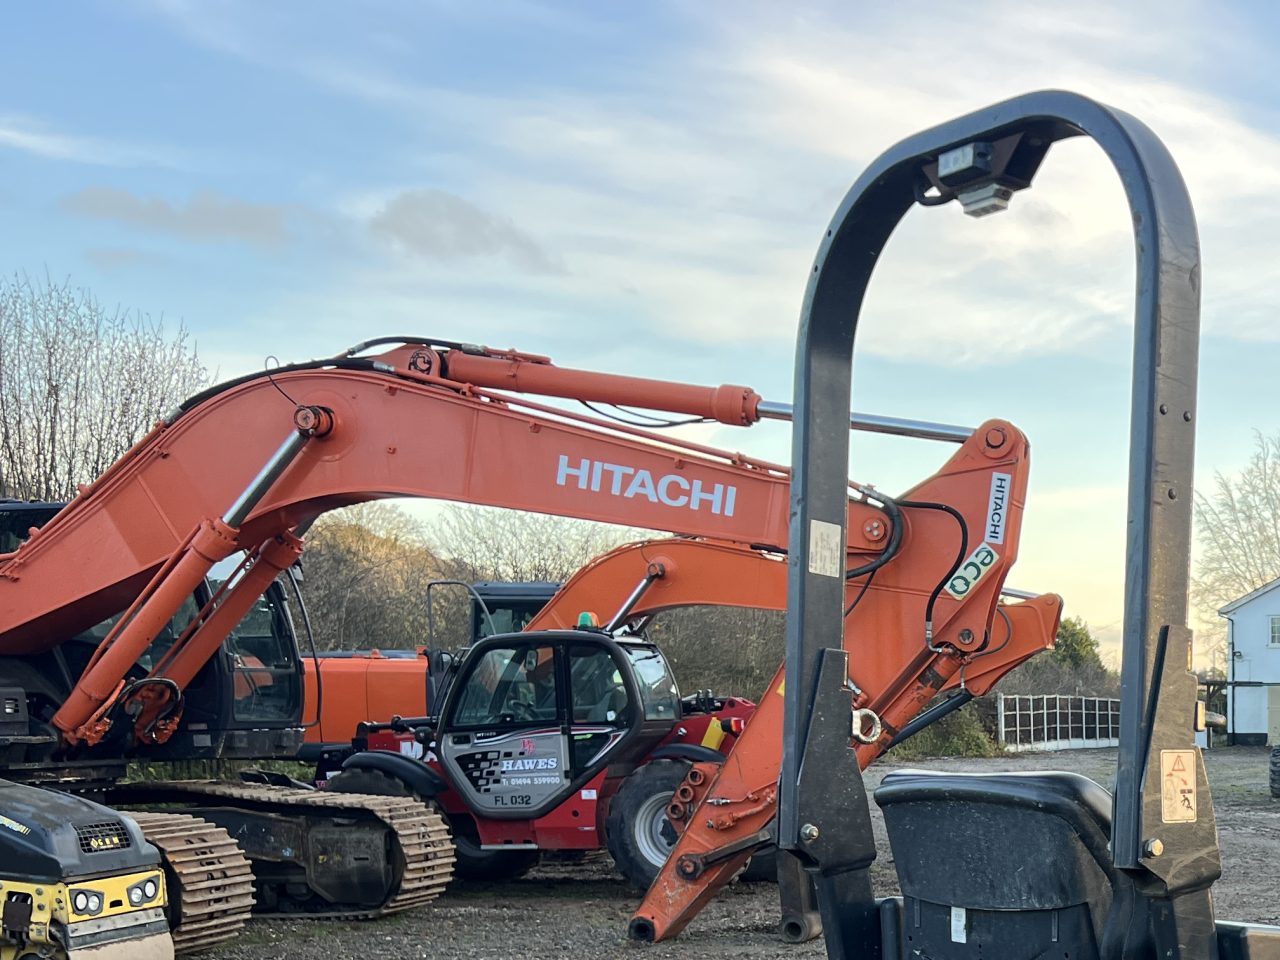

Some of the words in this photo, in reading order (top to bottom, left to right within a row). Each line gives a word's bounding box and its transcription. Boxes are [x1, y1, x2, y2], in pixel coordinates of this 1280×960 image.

[556, 454, 737, 517] HITACHI
[988, 477, 1007, 540] HITACHI
[949, 547, 994, 595] eco
[501, 758, 558, 771] HAWES
[494, 795, 508, 806] FL
[510, 794, 532, 806] 032
